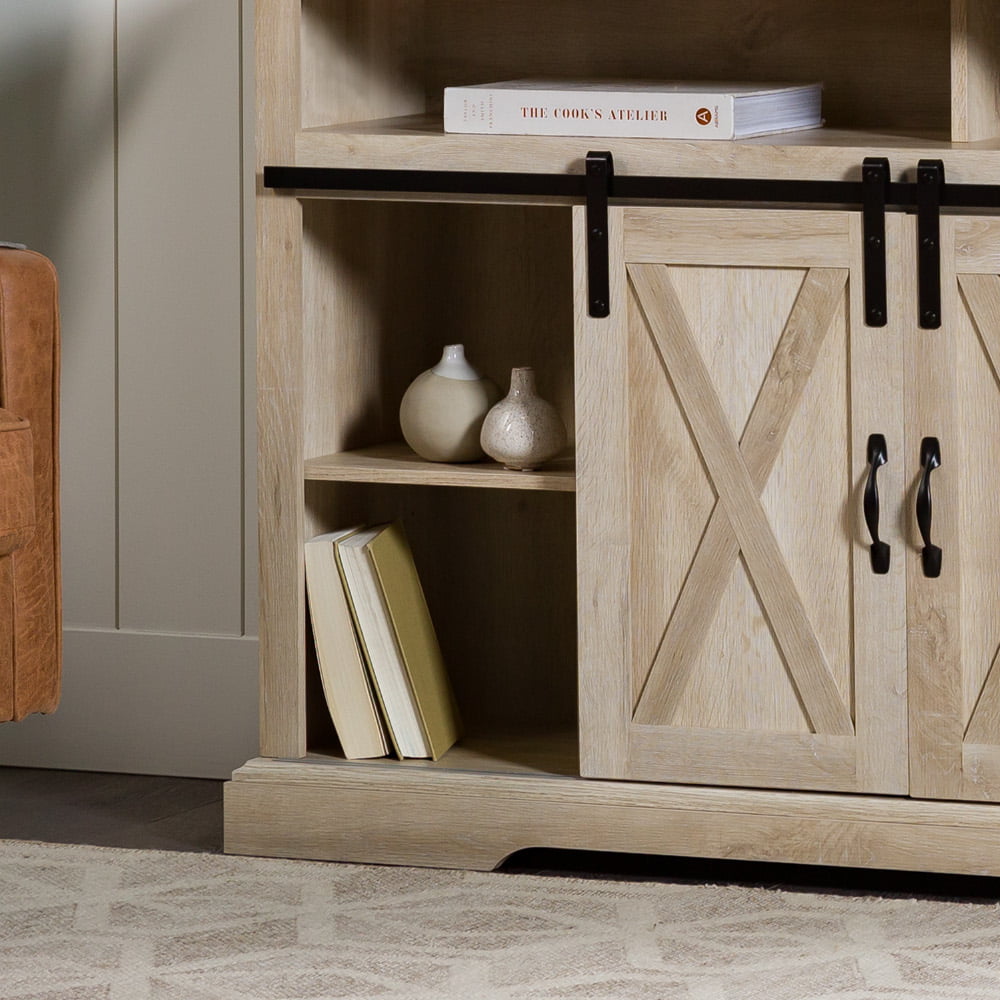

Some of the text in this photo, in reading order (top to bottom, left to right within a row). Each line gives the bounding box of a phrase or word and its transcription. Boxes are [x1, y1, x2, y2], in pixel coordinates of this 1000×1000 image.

[520, 106, 668, 121] THE COOK'S ATELIER
